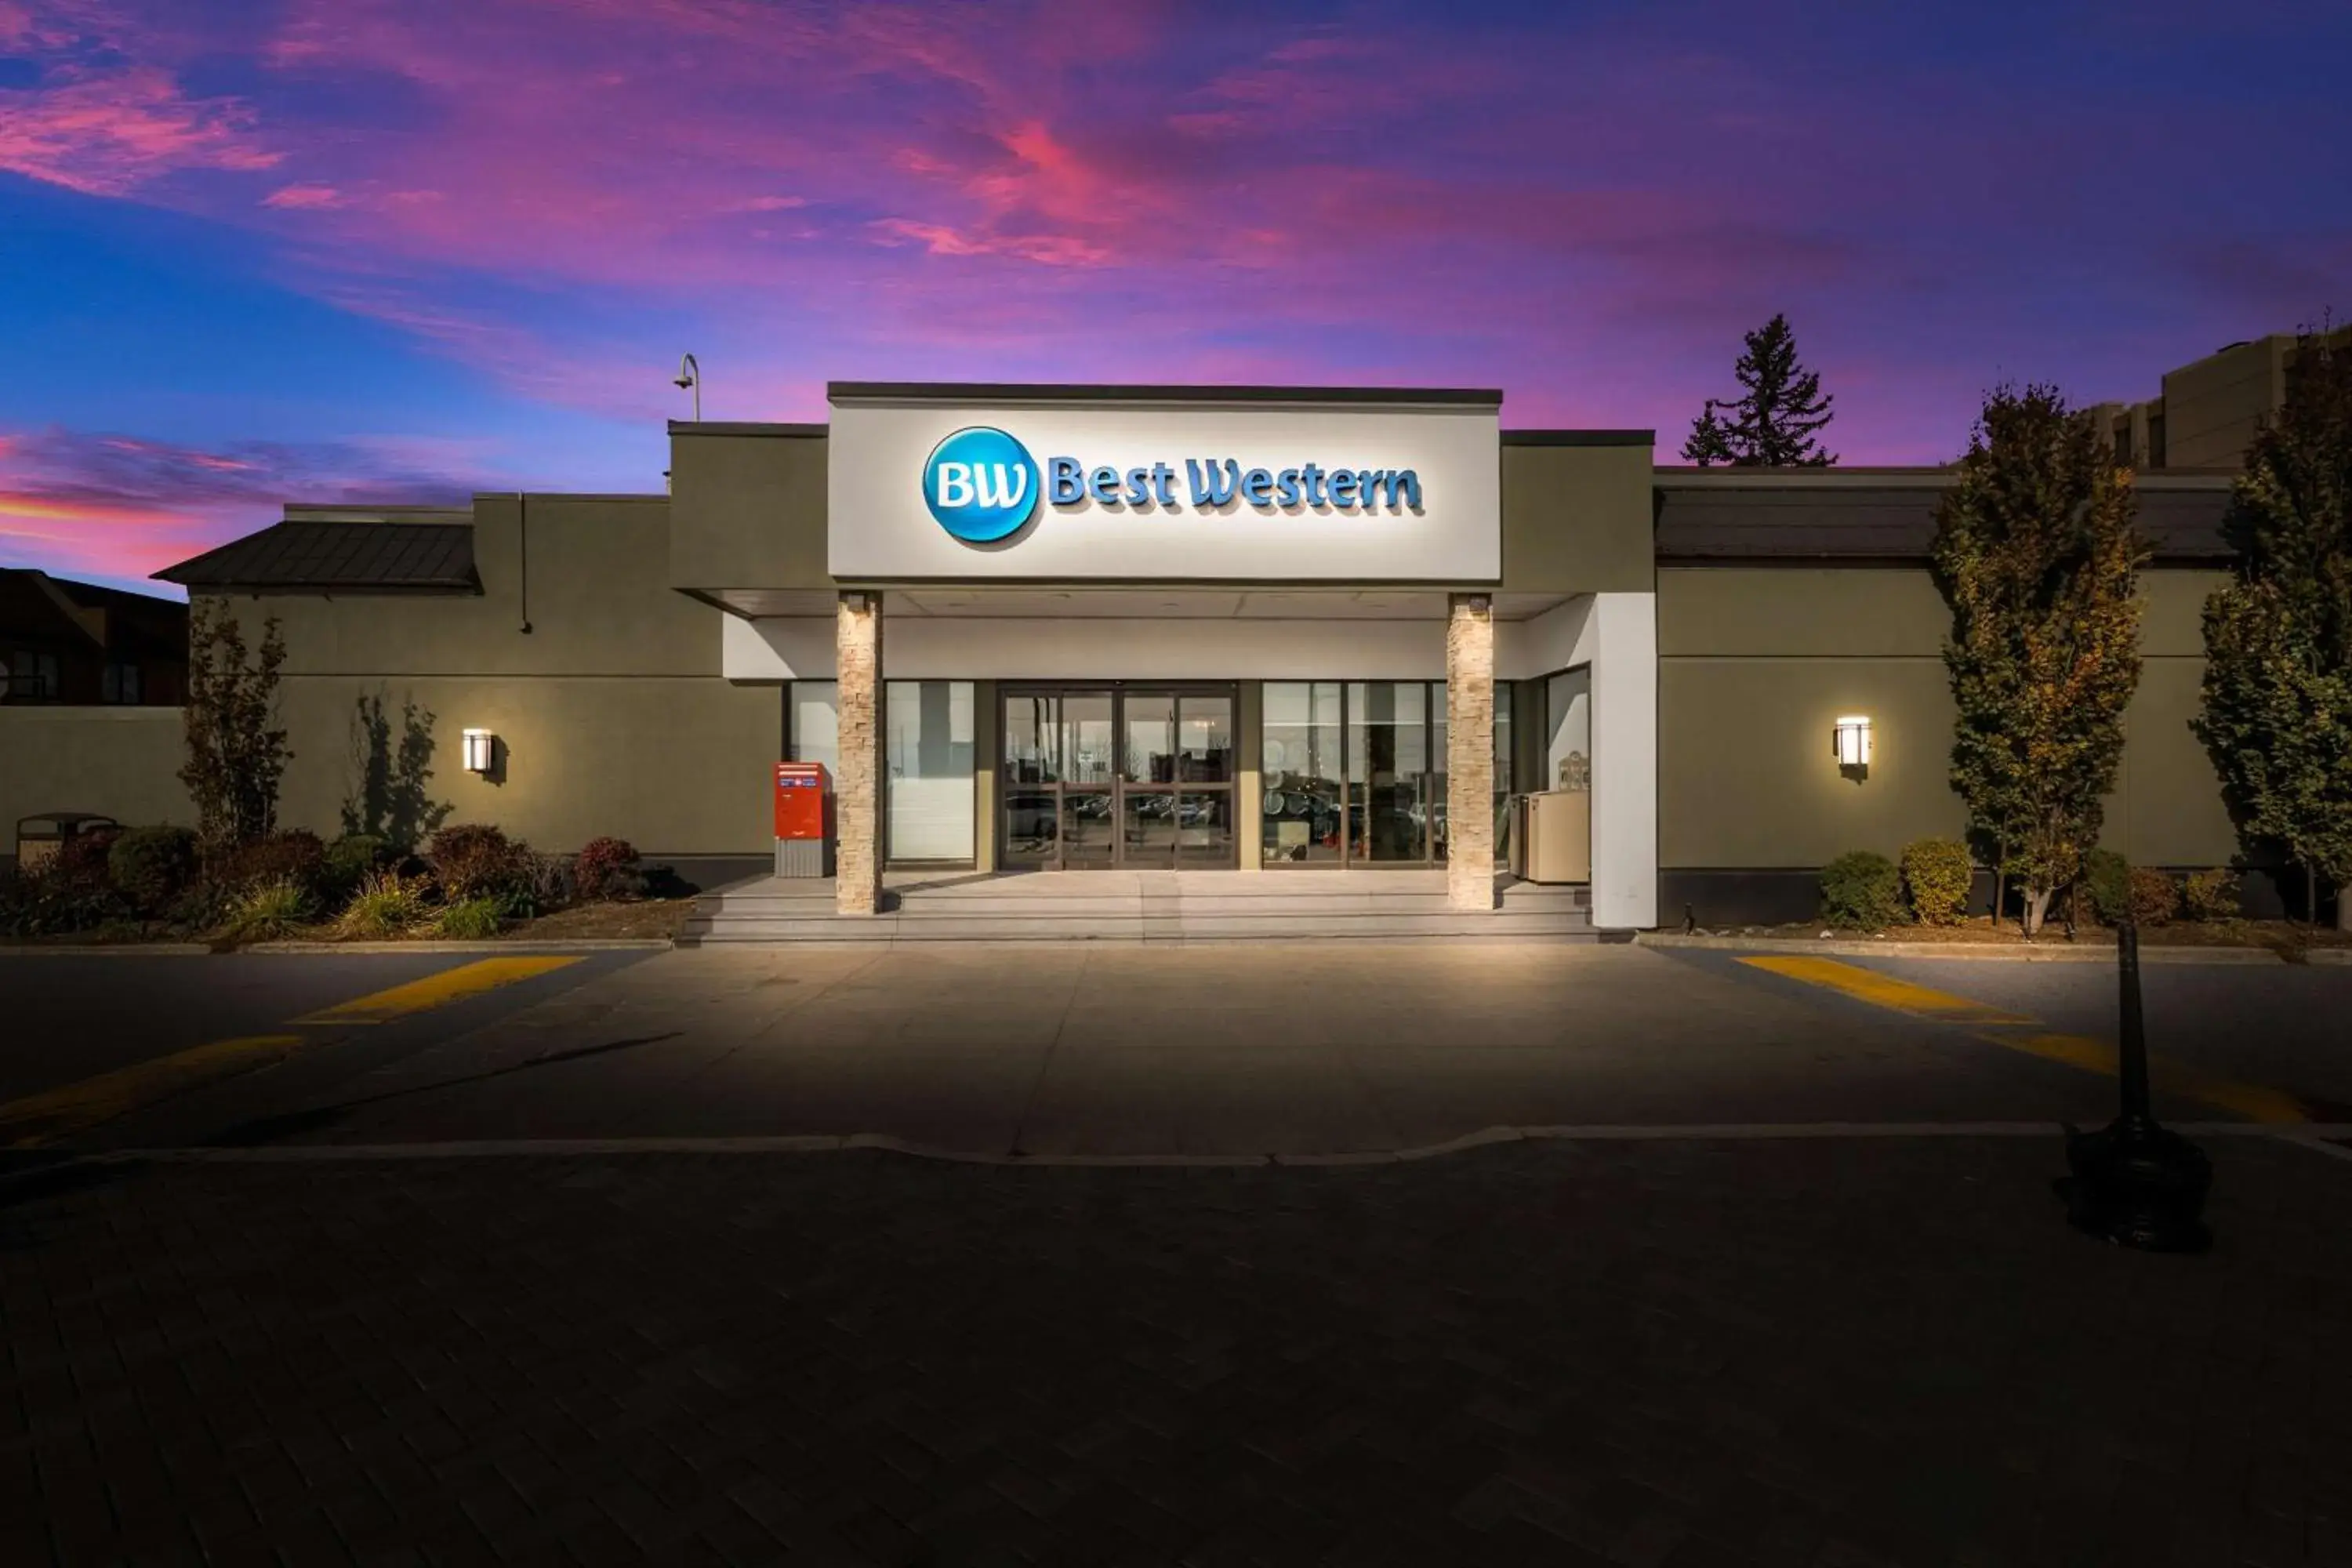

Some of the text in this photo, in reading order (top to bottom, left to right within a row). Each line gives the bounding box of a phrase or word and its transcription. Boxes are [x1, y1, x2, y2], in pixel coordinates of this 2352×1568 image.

[938, 462, 1027, 508] BW
[1048, 457, 1421, 510] Best Western
